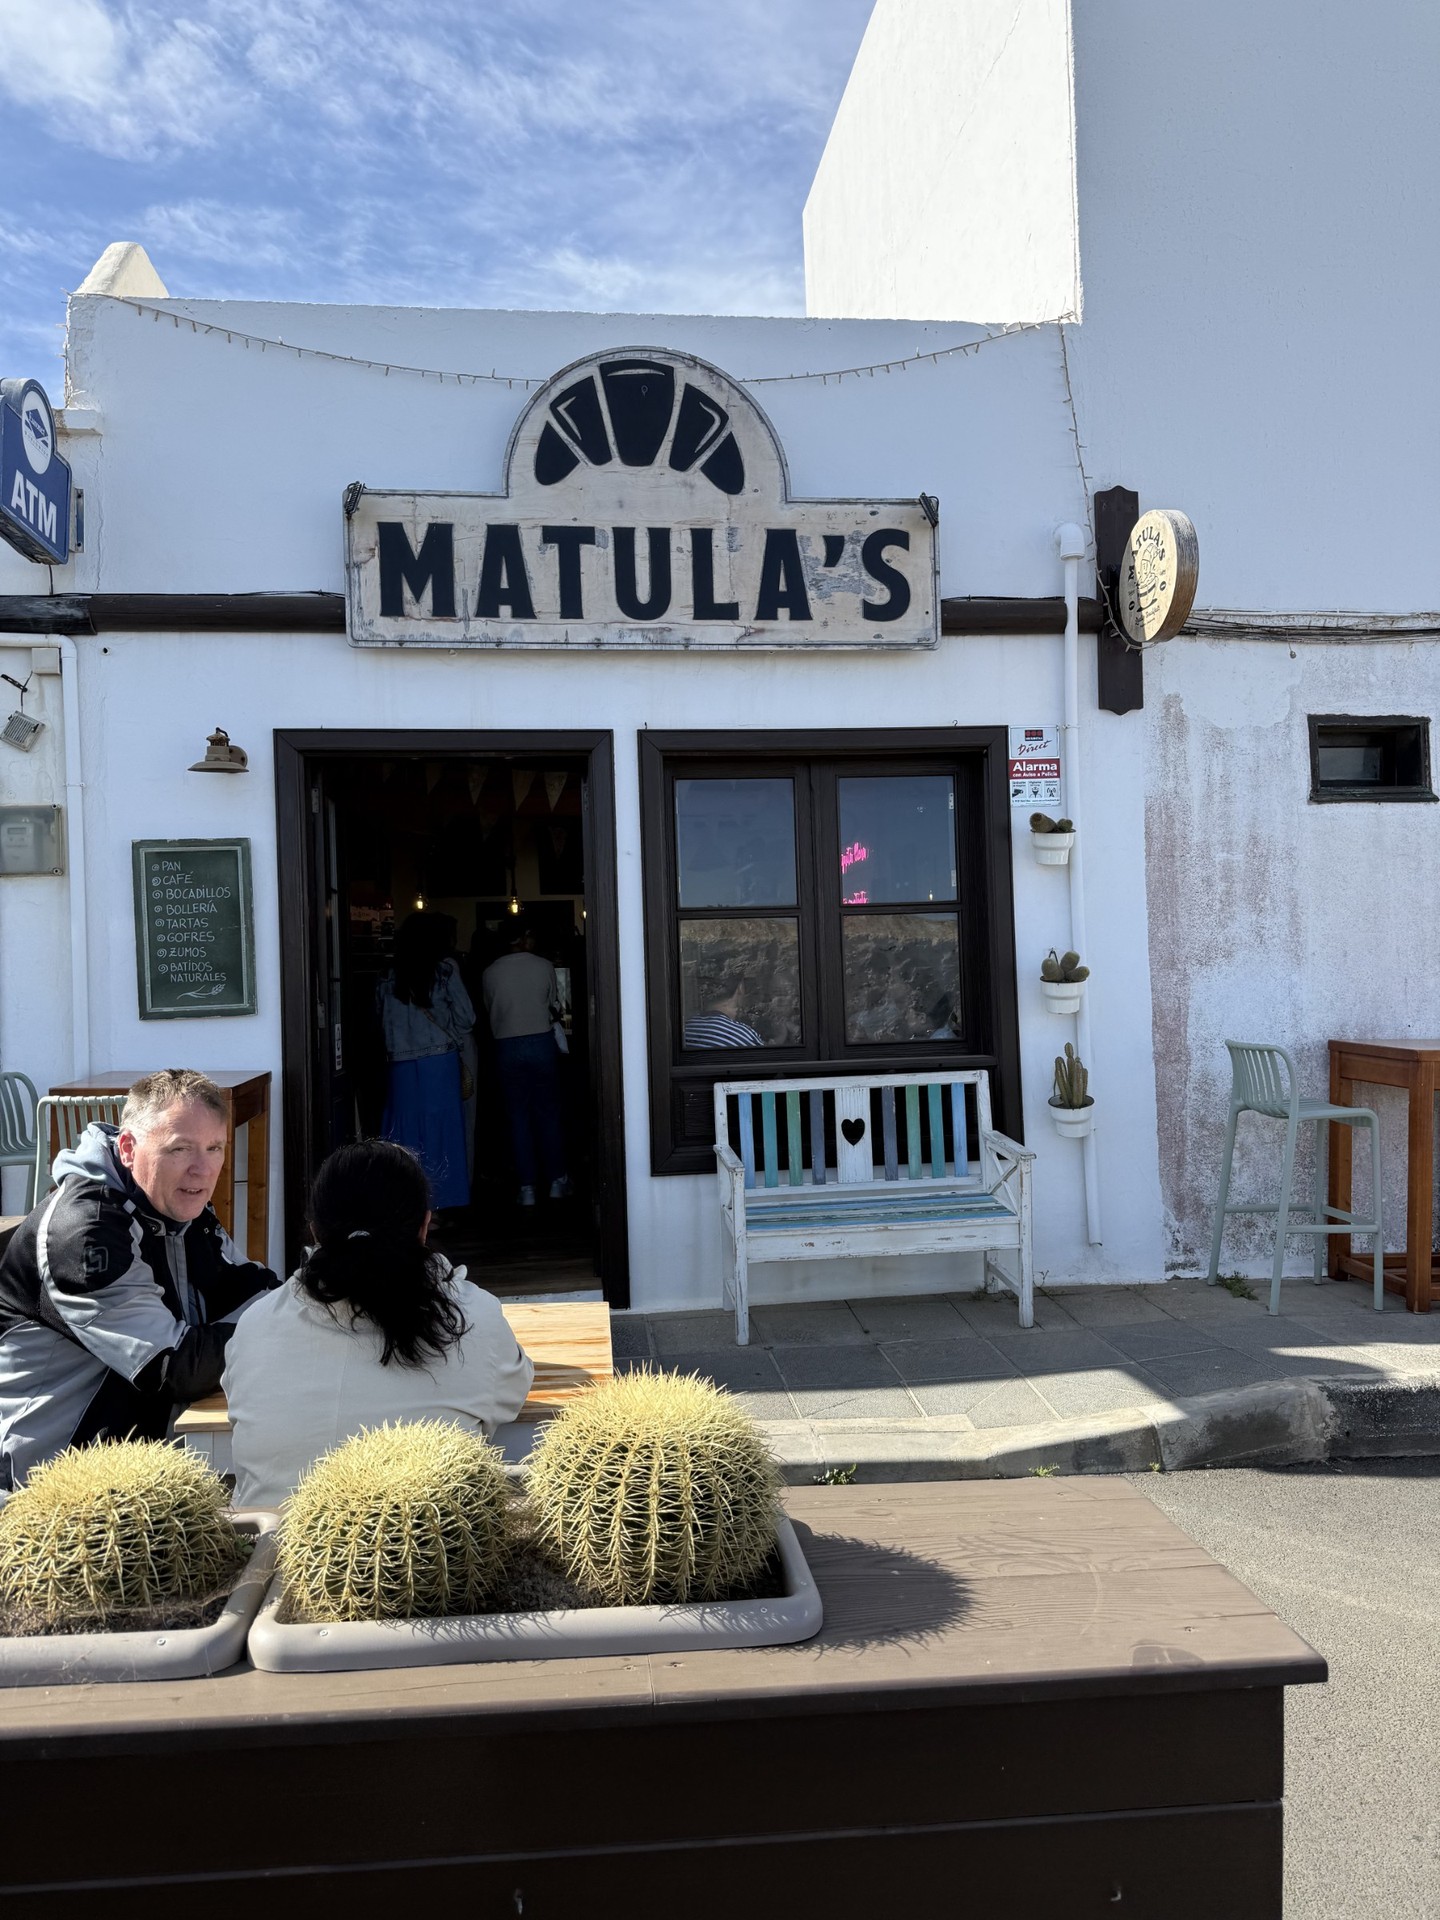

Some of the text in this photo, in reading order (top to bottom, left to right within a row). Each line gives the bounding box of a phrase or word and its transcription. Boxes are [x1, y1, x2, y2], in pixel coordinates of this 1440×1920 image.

[10, 469, 57, 544] ATM
[377, 521, 911, 622] MATULA'S
[1017, 739, 1053, 756] Direct
[1013, 760, 1057, 772] Alarma
[161, 860, 181, 871] PAN
[162, 871, 194, 885] CAFÉ
[166, 885, 231, 900] BOCADILLOS
[166, 900, 218, 916] BOLLERÍA
[166, 917, 209, 929] TARTAS
[167, 931, 215, 943] GOFRES
[168, 946, 207, 958] ZUMOS
[170, 960, 213, 972] BATIDOS
[170, 972, 227, 983] NATURALES
